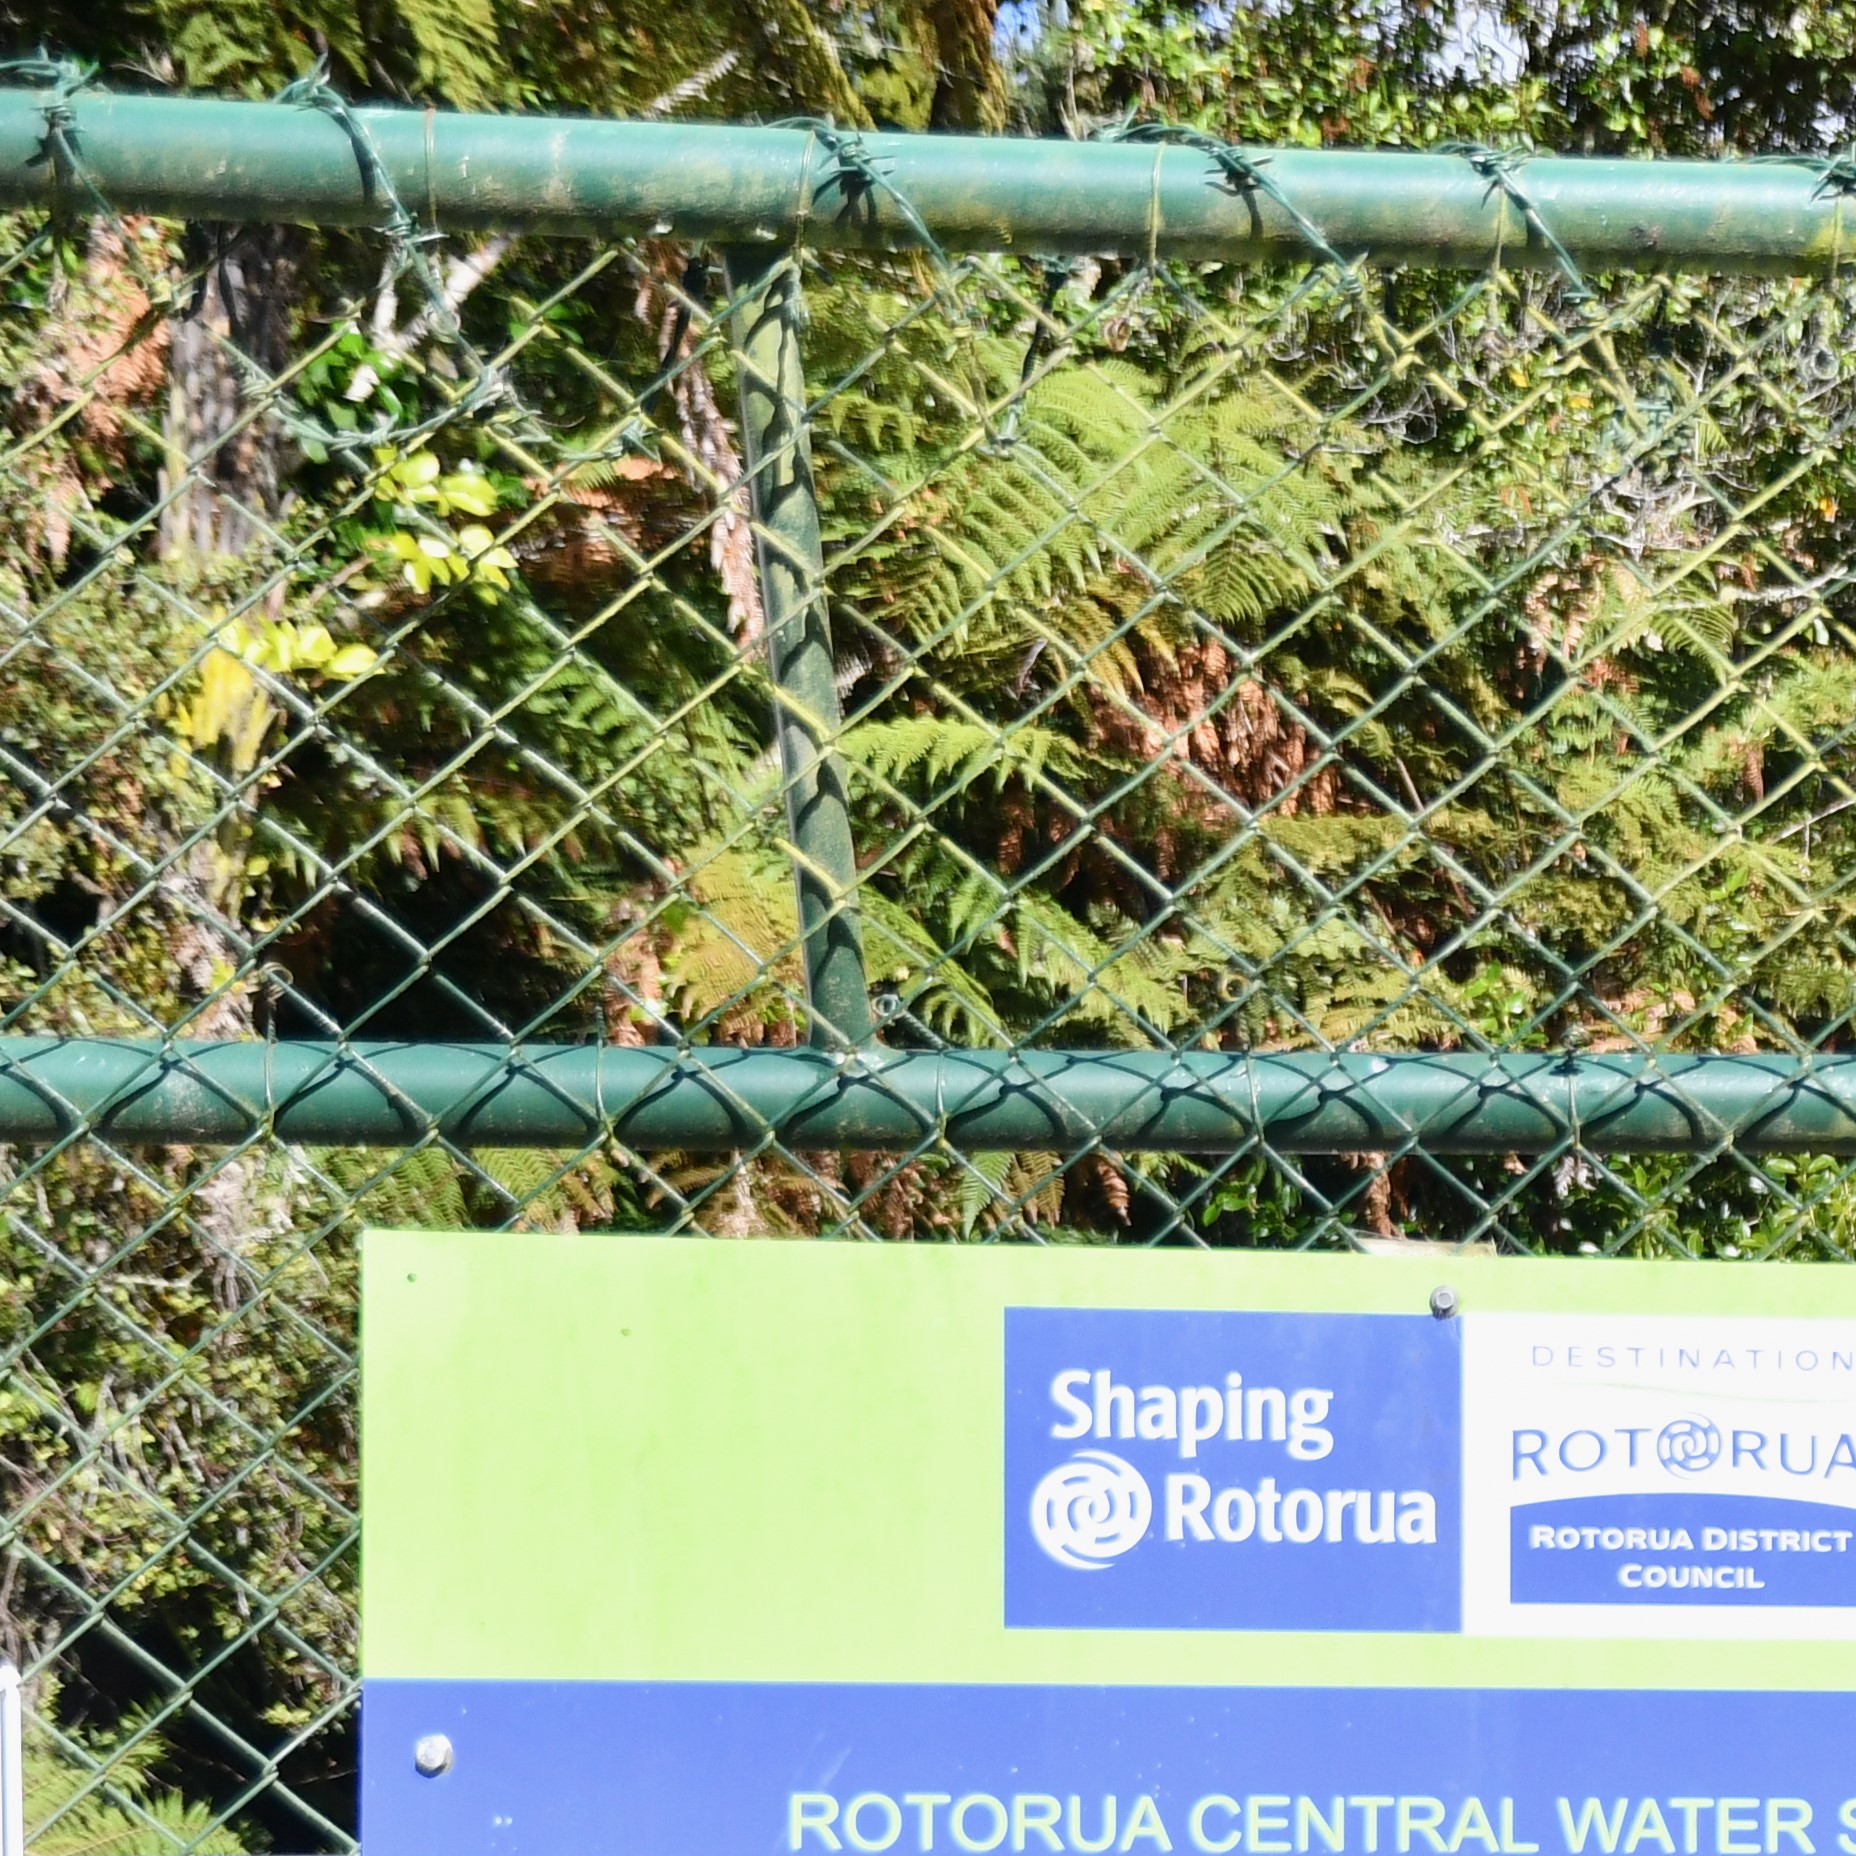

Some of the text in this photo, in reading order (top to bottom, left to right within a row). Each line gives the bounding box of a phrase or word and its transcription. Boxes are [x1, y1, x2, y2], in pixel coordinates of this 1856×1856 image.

[1532, 1345, 1856, 1371] DESTINATION
[1051, 1369, 1334, 1462] Shaping
[1166, 1473, 1437, 1544] Rotorua
[1530, 1525, 1853, 1553] ROTORUA DISTRICT
[1618, 1563, 1765, 1589] COUNCIL
[789, 1792, 1173, 1853] ROTORUA
[1189, 1794, 1540, 1854] CENTRAL
[1557, 1797, 1816, 1854] WATER
